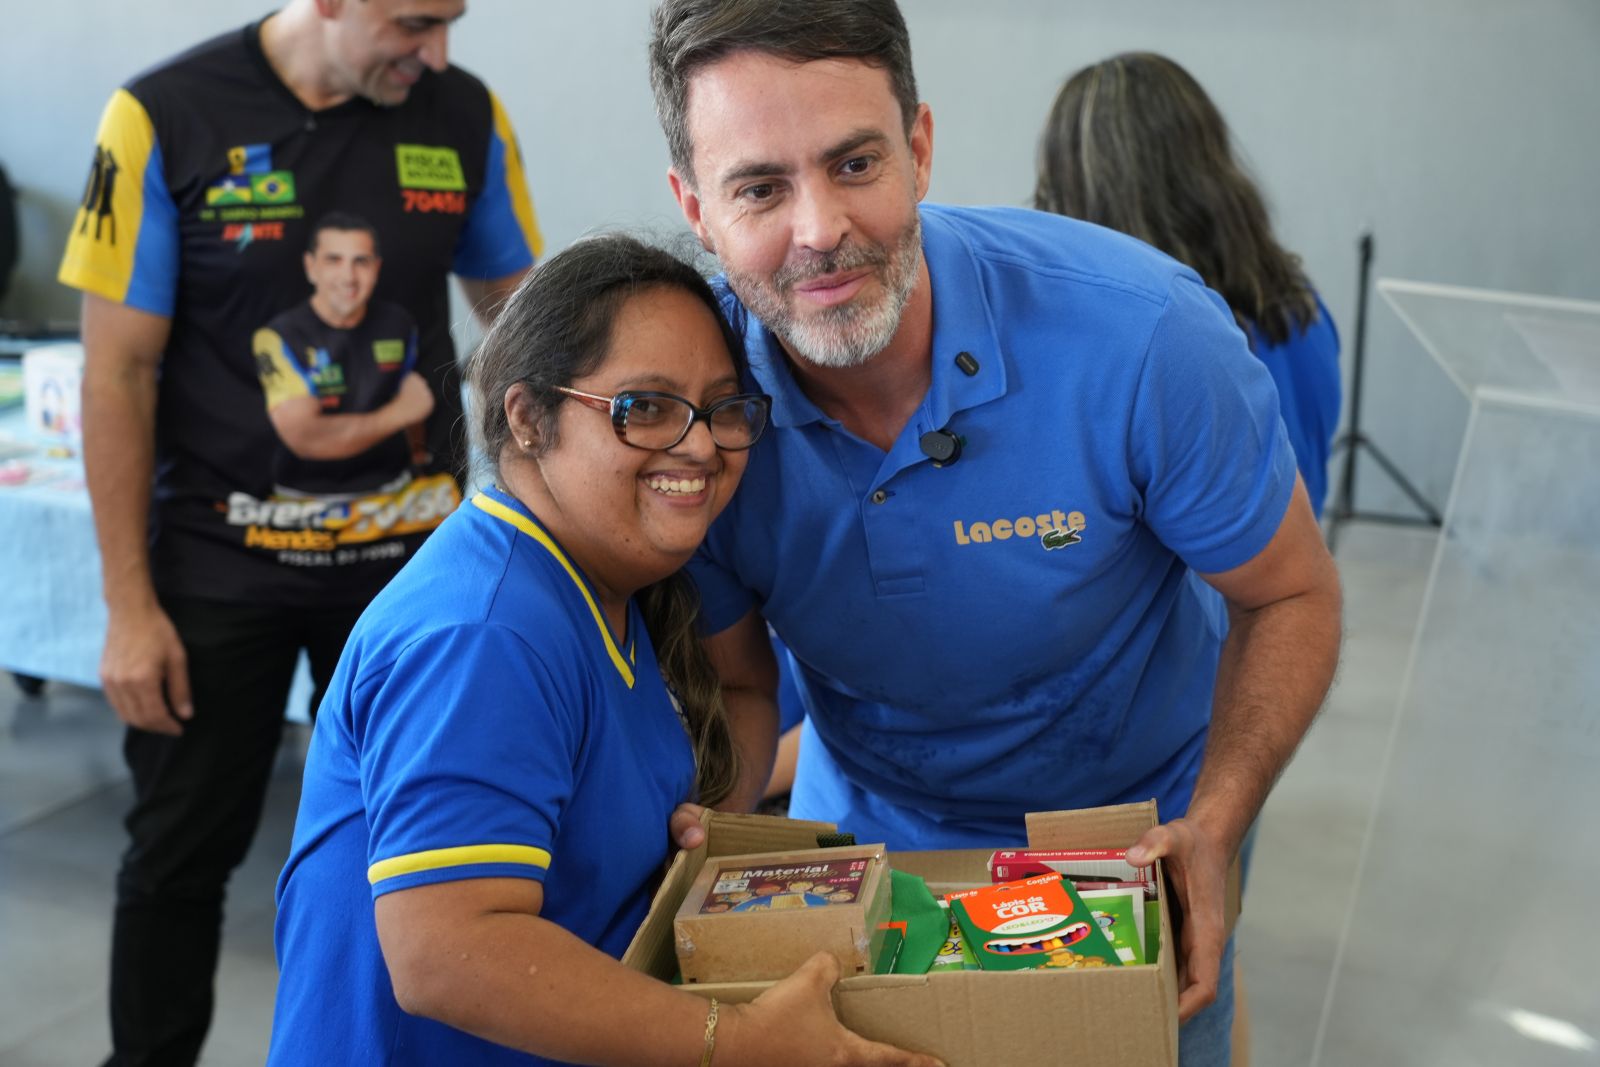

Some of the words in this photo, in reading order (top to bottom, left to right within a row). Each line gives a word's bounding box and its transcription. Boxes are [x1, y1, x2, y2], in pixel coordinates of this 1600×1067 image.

[953, 510, 1087, 545] Lacoste
[743, 864, 829, 878] Material
[1026, 874, 1060, 886] Contém
[992, 898, 1026, 910] Lápis
[996, 901, 1049, 919] COR
